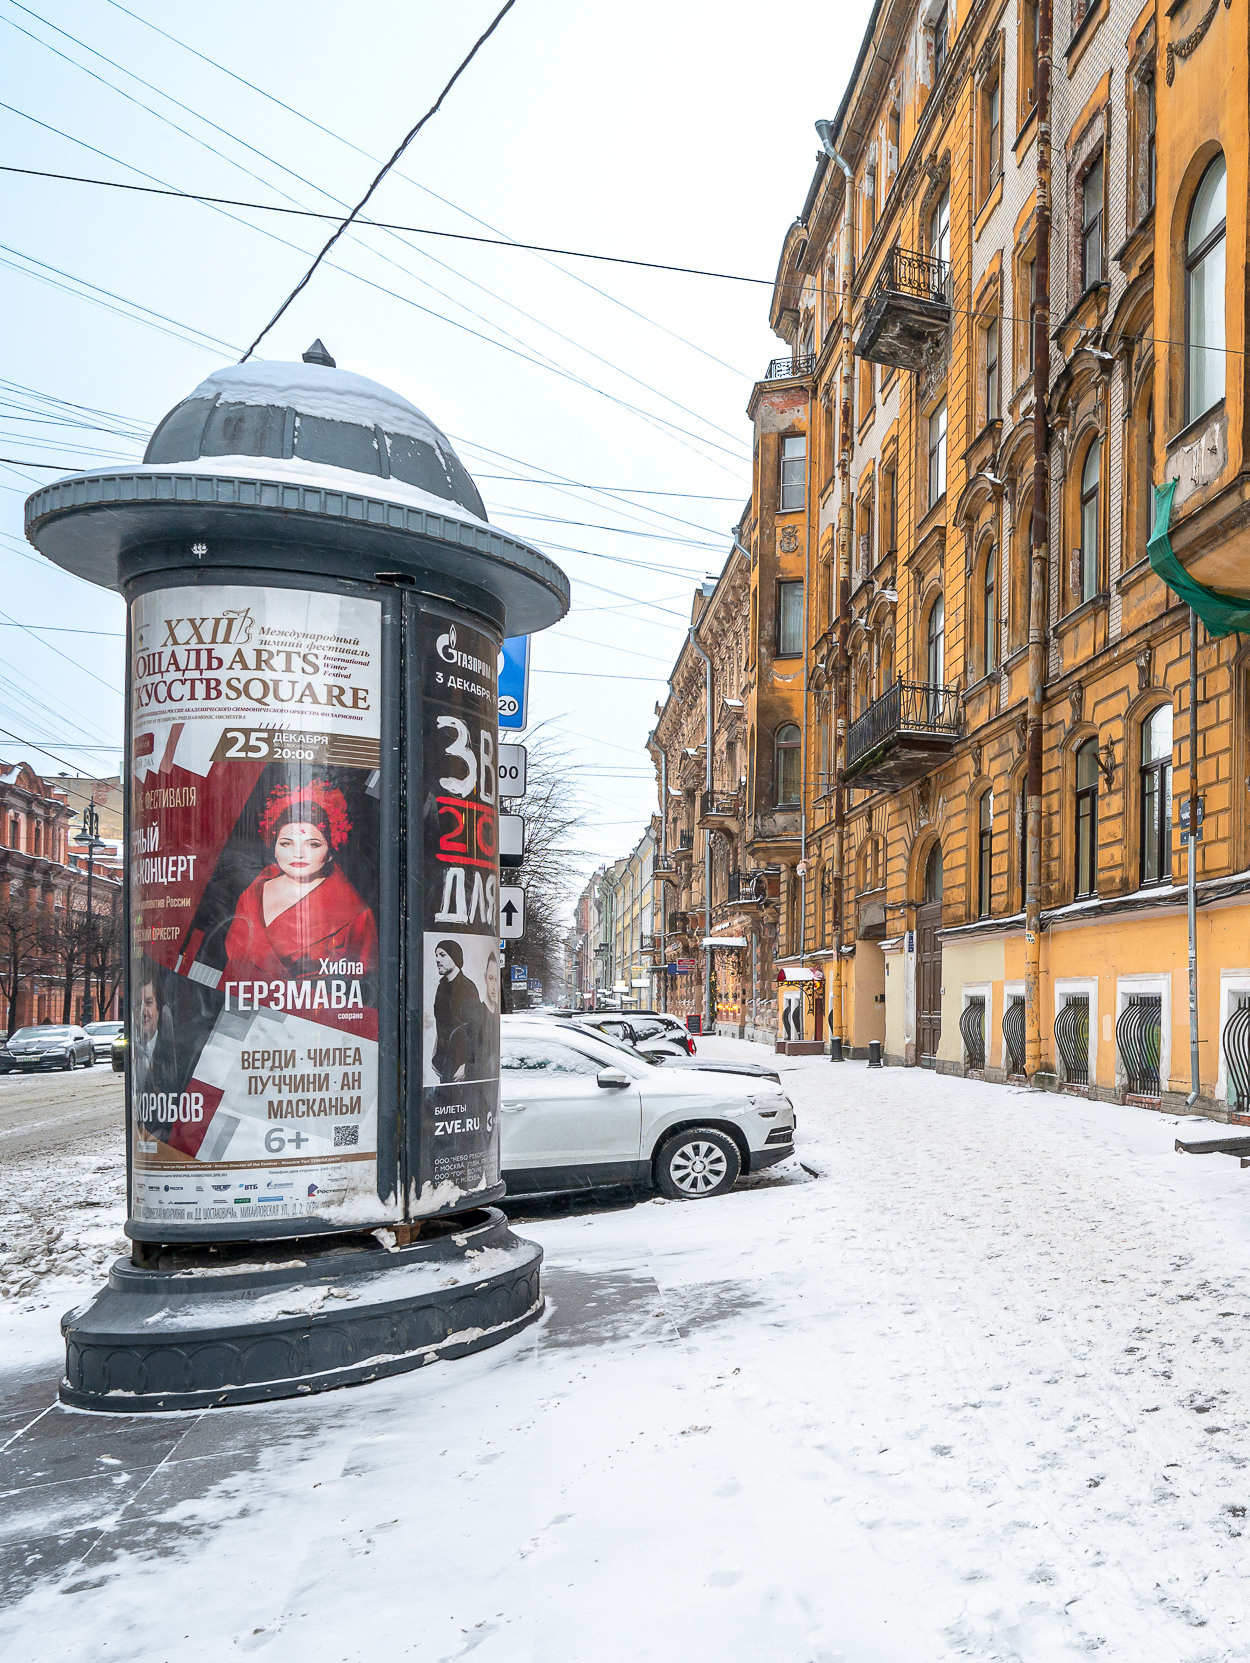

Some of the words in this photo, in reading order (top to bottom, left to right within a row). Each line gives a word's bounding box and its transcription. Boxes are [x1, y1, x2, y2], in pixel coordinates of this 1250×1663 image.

[258, 627, 360, 646] Международный
[258, 638, 303, 649] зимний
[306, 643, 370, 658] фестиваль
[134, 648, 224, 681] ОЩАДЬ
[226, 647, 320, 676] ARTS
[323, 654, 370, 667] International
[323, 662, 348, 671] Winter
[457, 650, 491, 680] ГАЗПРОМ
[323, 671, 351, 680] Festival
[436, 671, 444, 684] 3
[134, 677, 223, 712] КУССТВ
[225, 677, 371, 711] SQUARE
[498, 699, 517, 712] 20
[225, 731, 270, 758] 25
[273, 732, 329, 745] ДЕКАБРЯ
[273, 748, 315, 761] 20:00
[145, 786, 197, 810] ФЕСТИВАЛЯ
[166, 895, 191, 908] России
[318, 957, 364, 976] Хибла
[224, 979, 364, 1012] ГЕРЗМАВА
[337, 1012, 364, 1021] сопрано
[241, 1049, 296, 1072] ВЕРДИ
[307, 1046, 362, 1068] ЧИЛЕА
[248, 1072, 330, 1096] ПУЧЧИНИ
[267, 1095, 362, 1120] МАСКАНЬИ
[434, 1104, 467, 1116] БИЛЕТЫ
[434, 1117, 480, 1136] ZVE.RU
[264, 1127, 309, 1154] 6+
[244, 1183, 258, 1191] ВТБ
